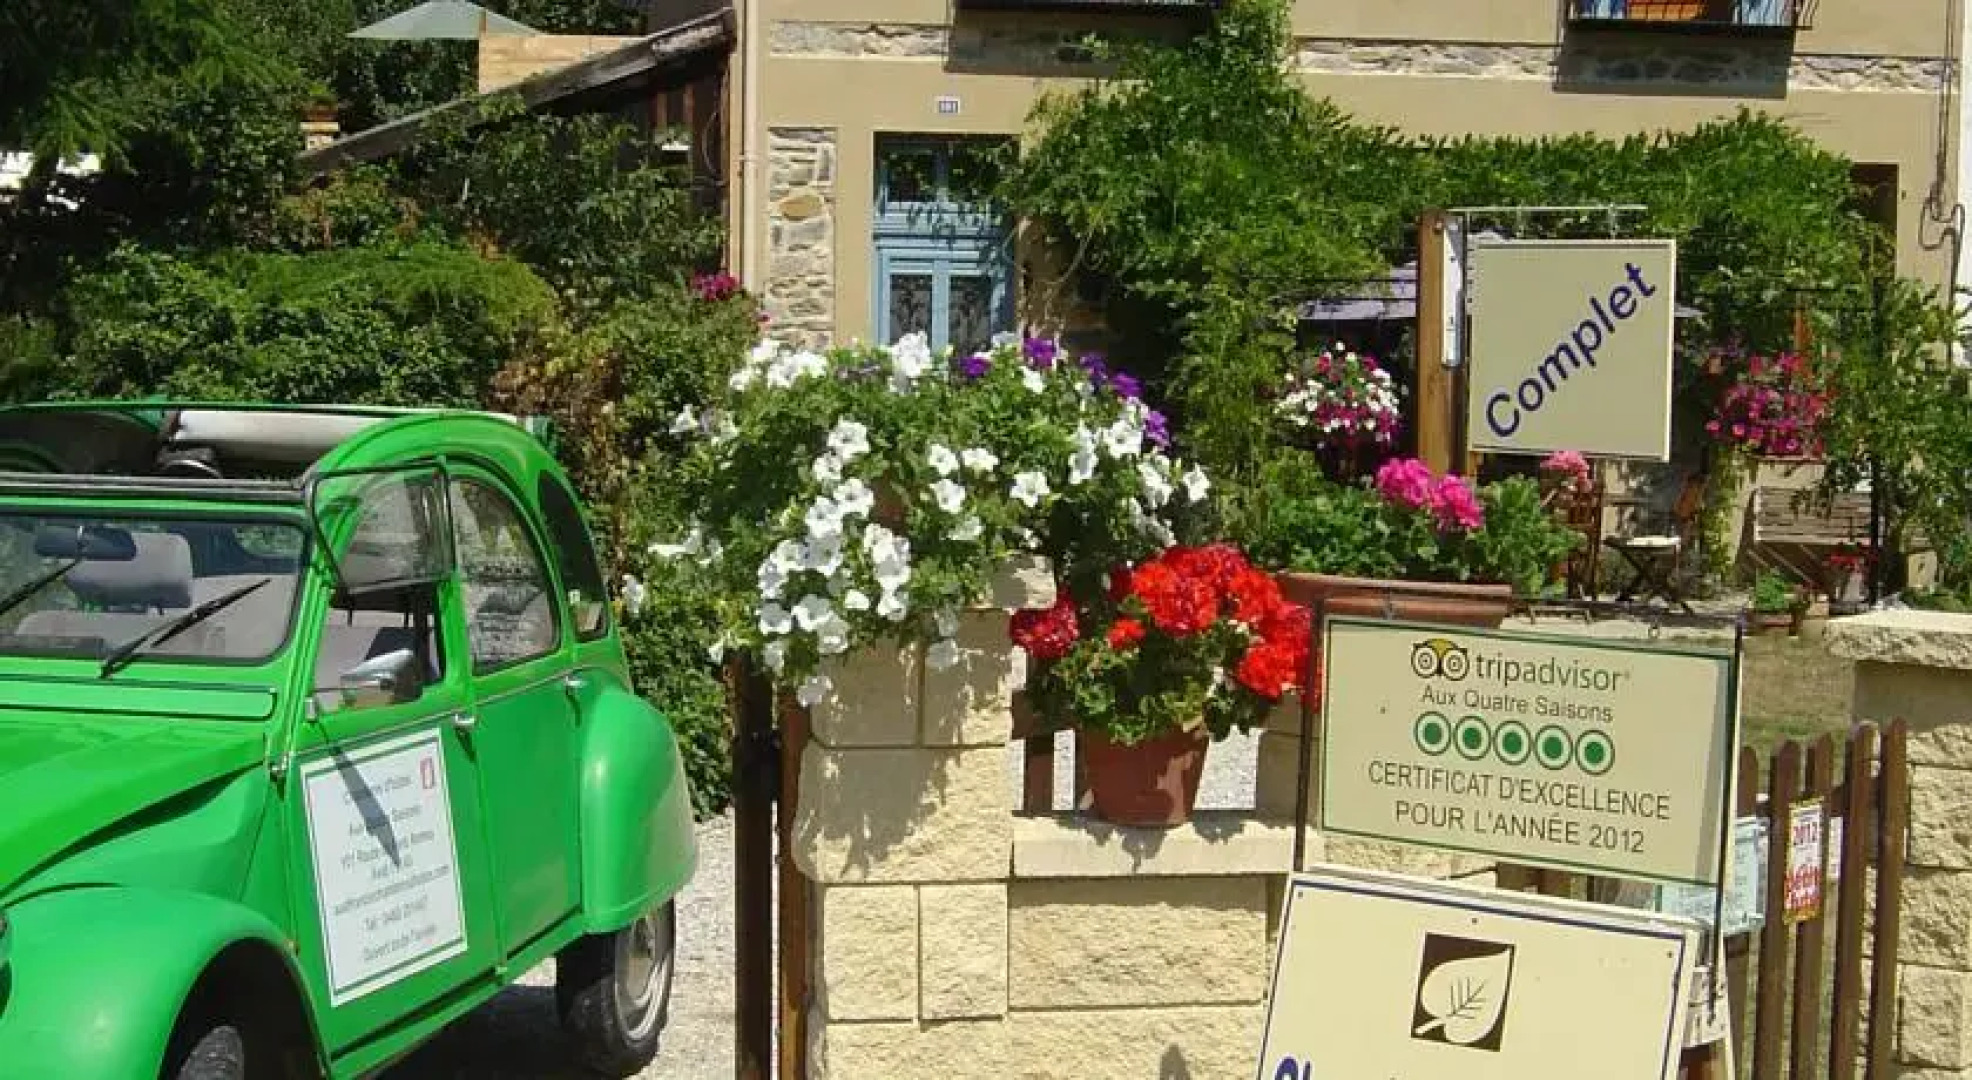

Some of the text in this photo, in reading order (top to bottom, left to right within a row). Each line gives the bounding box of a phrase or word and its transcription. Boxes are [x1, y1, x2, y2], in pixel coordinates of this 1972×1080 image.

[1486, 262, 1657, 437] Complet
[1476, 653, 1623, 692] tripadvisor
[1421, 685, 1614, 722] Aux Quatre Saisons
[1368, 760, 1671, 820] CERTIFICAT D'EXCELLENCE
[1396, 801, 1645, 852] POUR L'ANNÉE 2012
[1792, 822, 1819, 846] 2012
